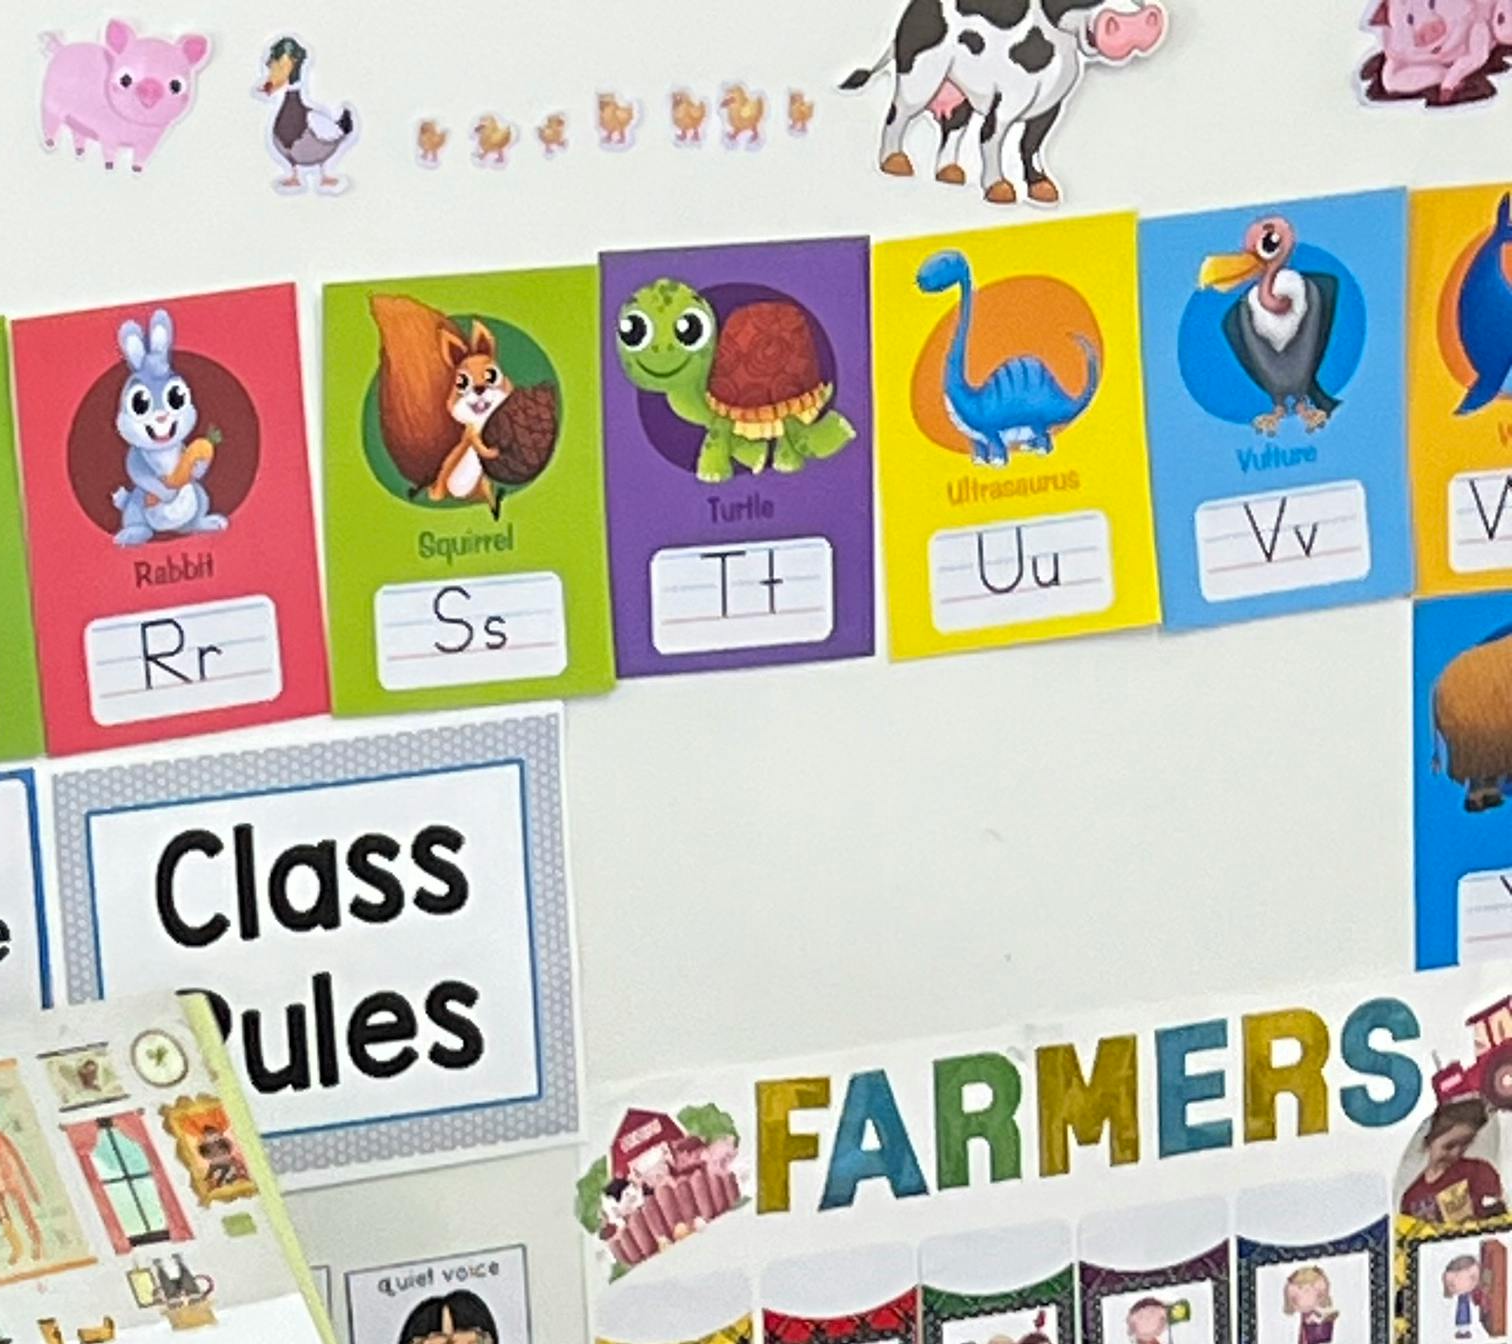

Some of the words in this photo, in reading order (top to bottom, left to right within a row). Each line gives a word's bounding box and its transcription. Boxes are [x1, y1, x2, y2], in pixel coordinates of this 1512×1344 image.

[946, 468, 1081, 507] Ultrasaurus
[1235, 443, 1318, 473] Vulture
[705, 495, 775, 525] Turtle
[1243, 497, 1319, 563] Vv
[133, 552, 214, 588] Rabbit
[418, 523, 514, 566] Squirrel
[977, 526, 1061, 595] Uu
[700, 548, 783, 619] Tt
[432, 585, 508, 654] Ss
[140, 618, 221, 691] Rr
[154, 823, 470, 949] Class
[753, 997, 1422, 1215] FARMERS
[377, 1270, 434, 1298] quiet
[442, 1260, 500, 1283] voice
